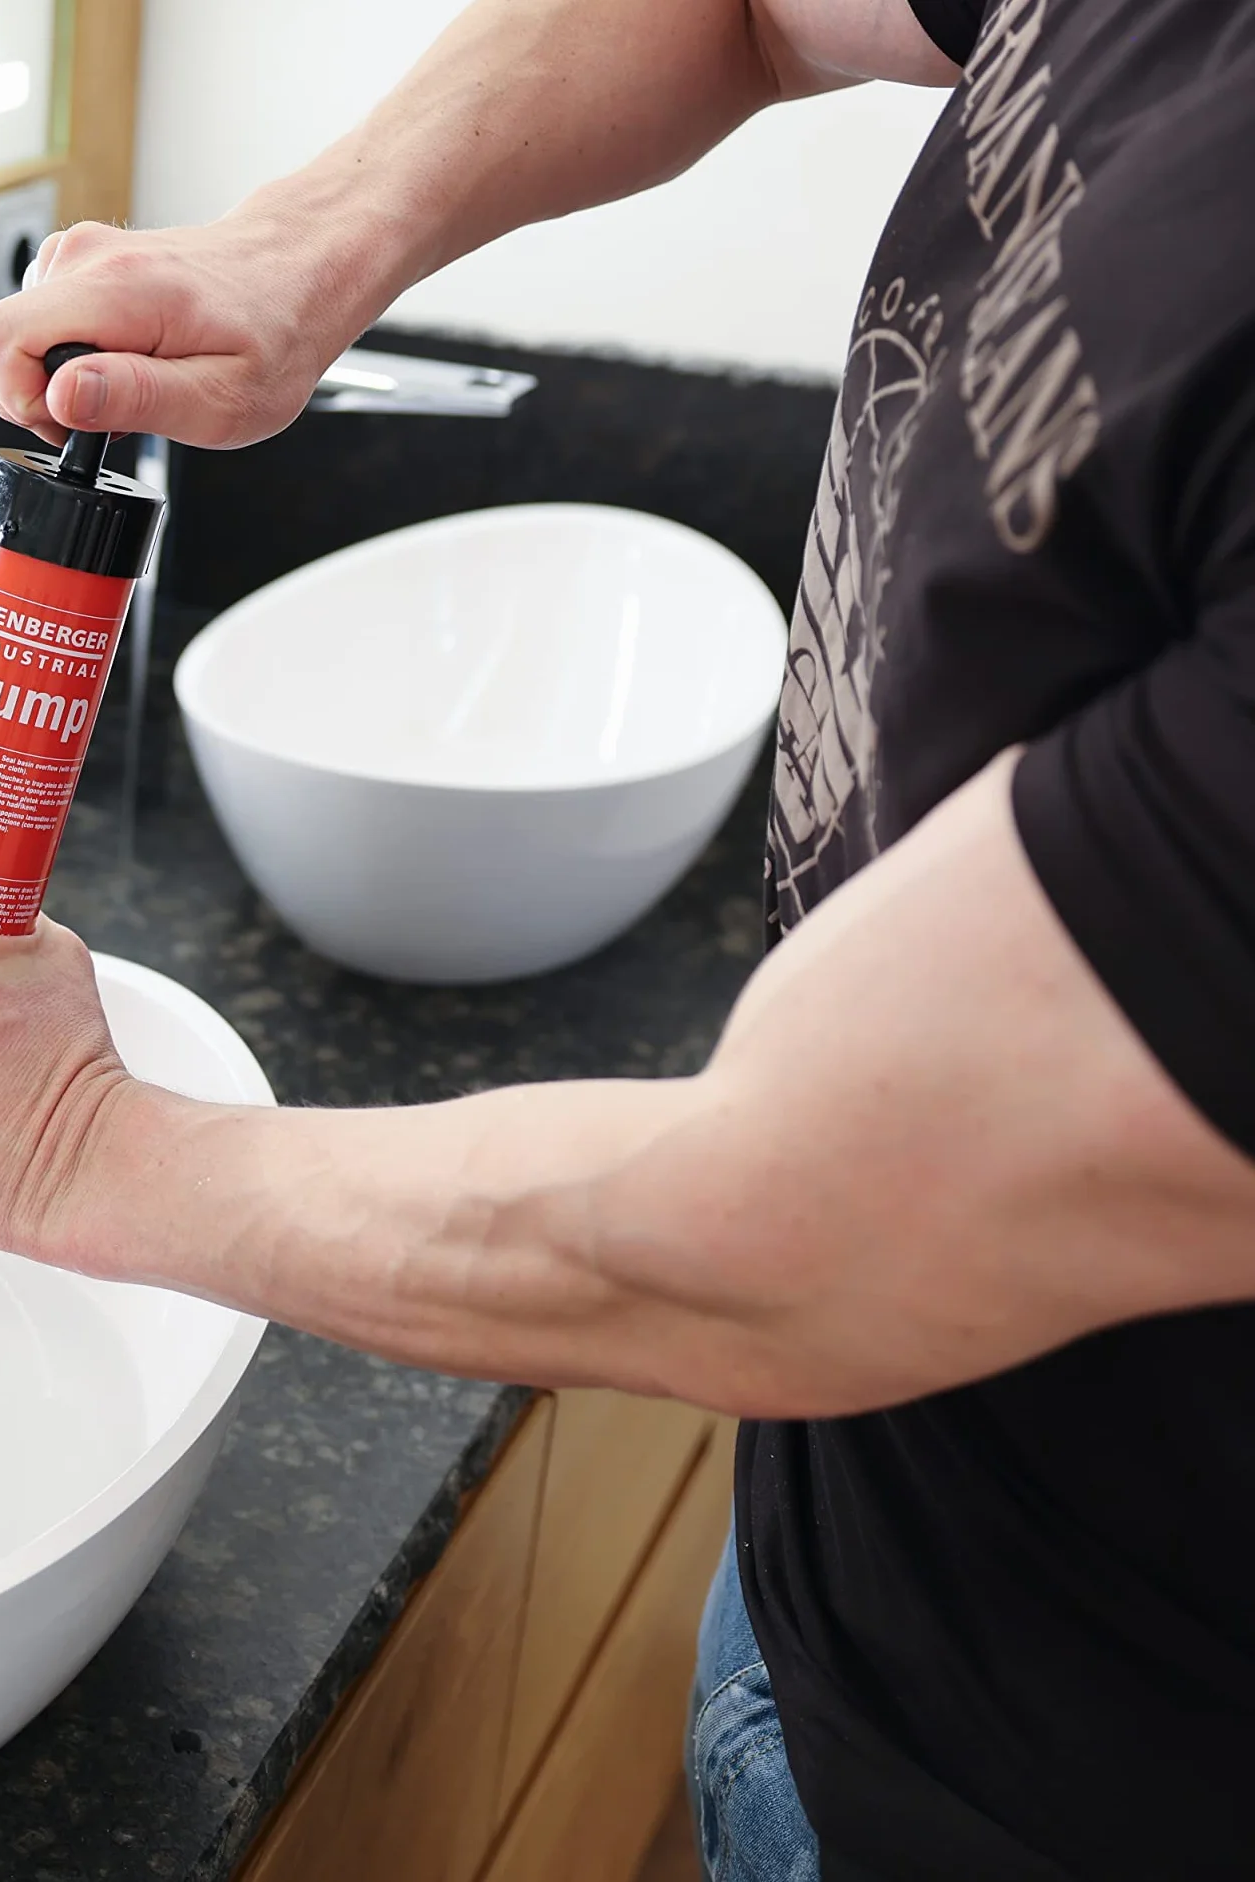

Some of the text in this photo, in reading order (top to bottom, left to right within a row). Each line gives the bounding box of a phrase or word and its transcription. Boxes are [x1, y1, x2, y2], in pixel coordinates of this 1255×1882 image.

[1, 754, 16, 764] Seal
[17, 758, 34, 768] basin
[35, 763, 58, 772] overflow
[7, 764, 27, 774] cloth).
[13, 784, 25, 792] une
[21, 820, 34, 829] (con
